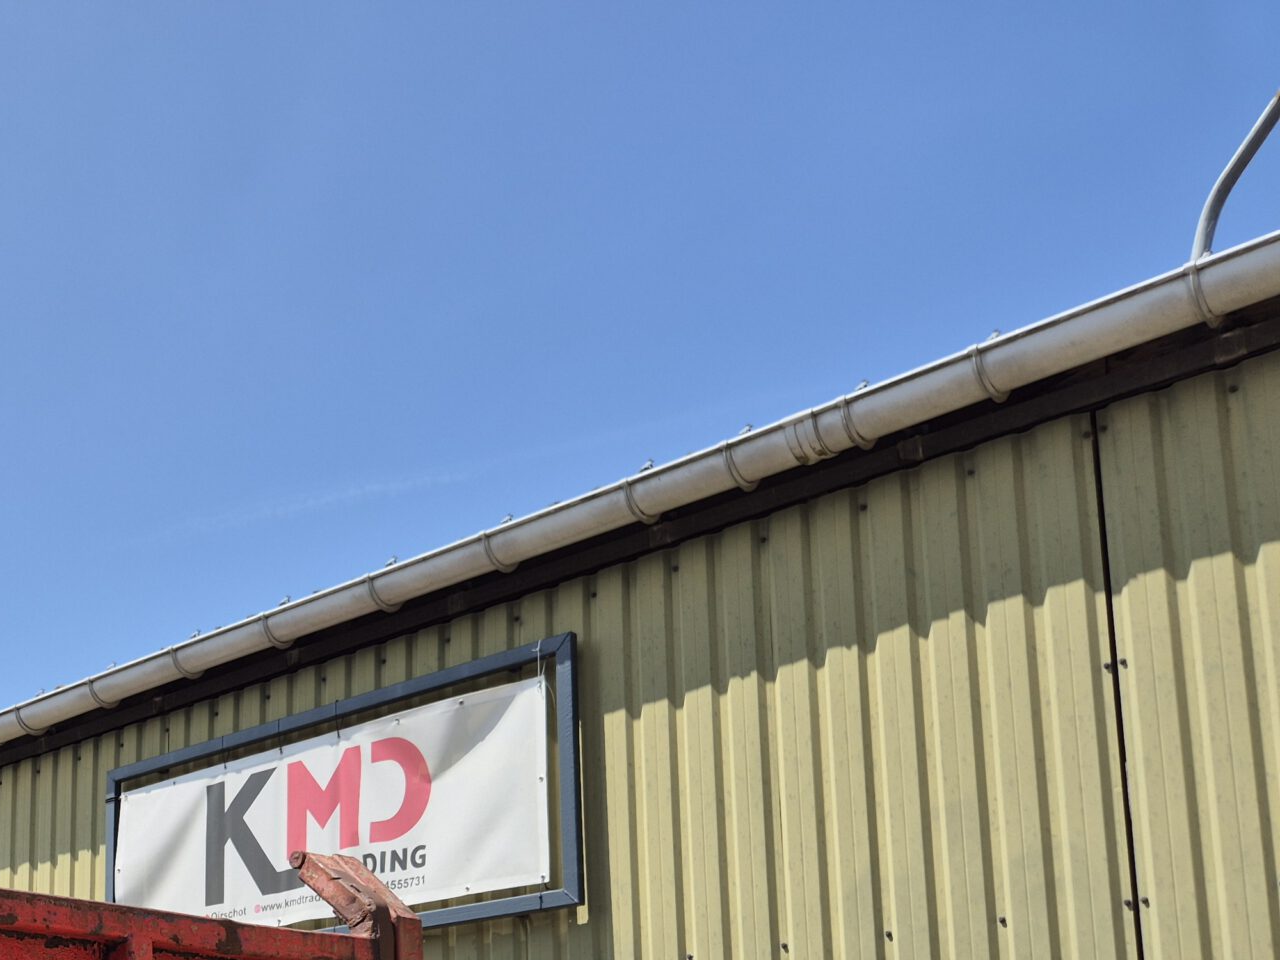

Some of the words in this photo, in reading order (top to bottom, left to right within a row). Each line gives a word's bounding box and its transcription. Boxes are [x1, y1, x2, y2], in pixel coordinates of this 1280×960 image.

[205, 737, 432, 907] KMD
[362, 845, 427, 874] DING
[211, 907, 247, 919] Oirschot
[261, 895, 321, 911] www.kmdtrad
[385, 875, 426, 890] 4555731
